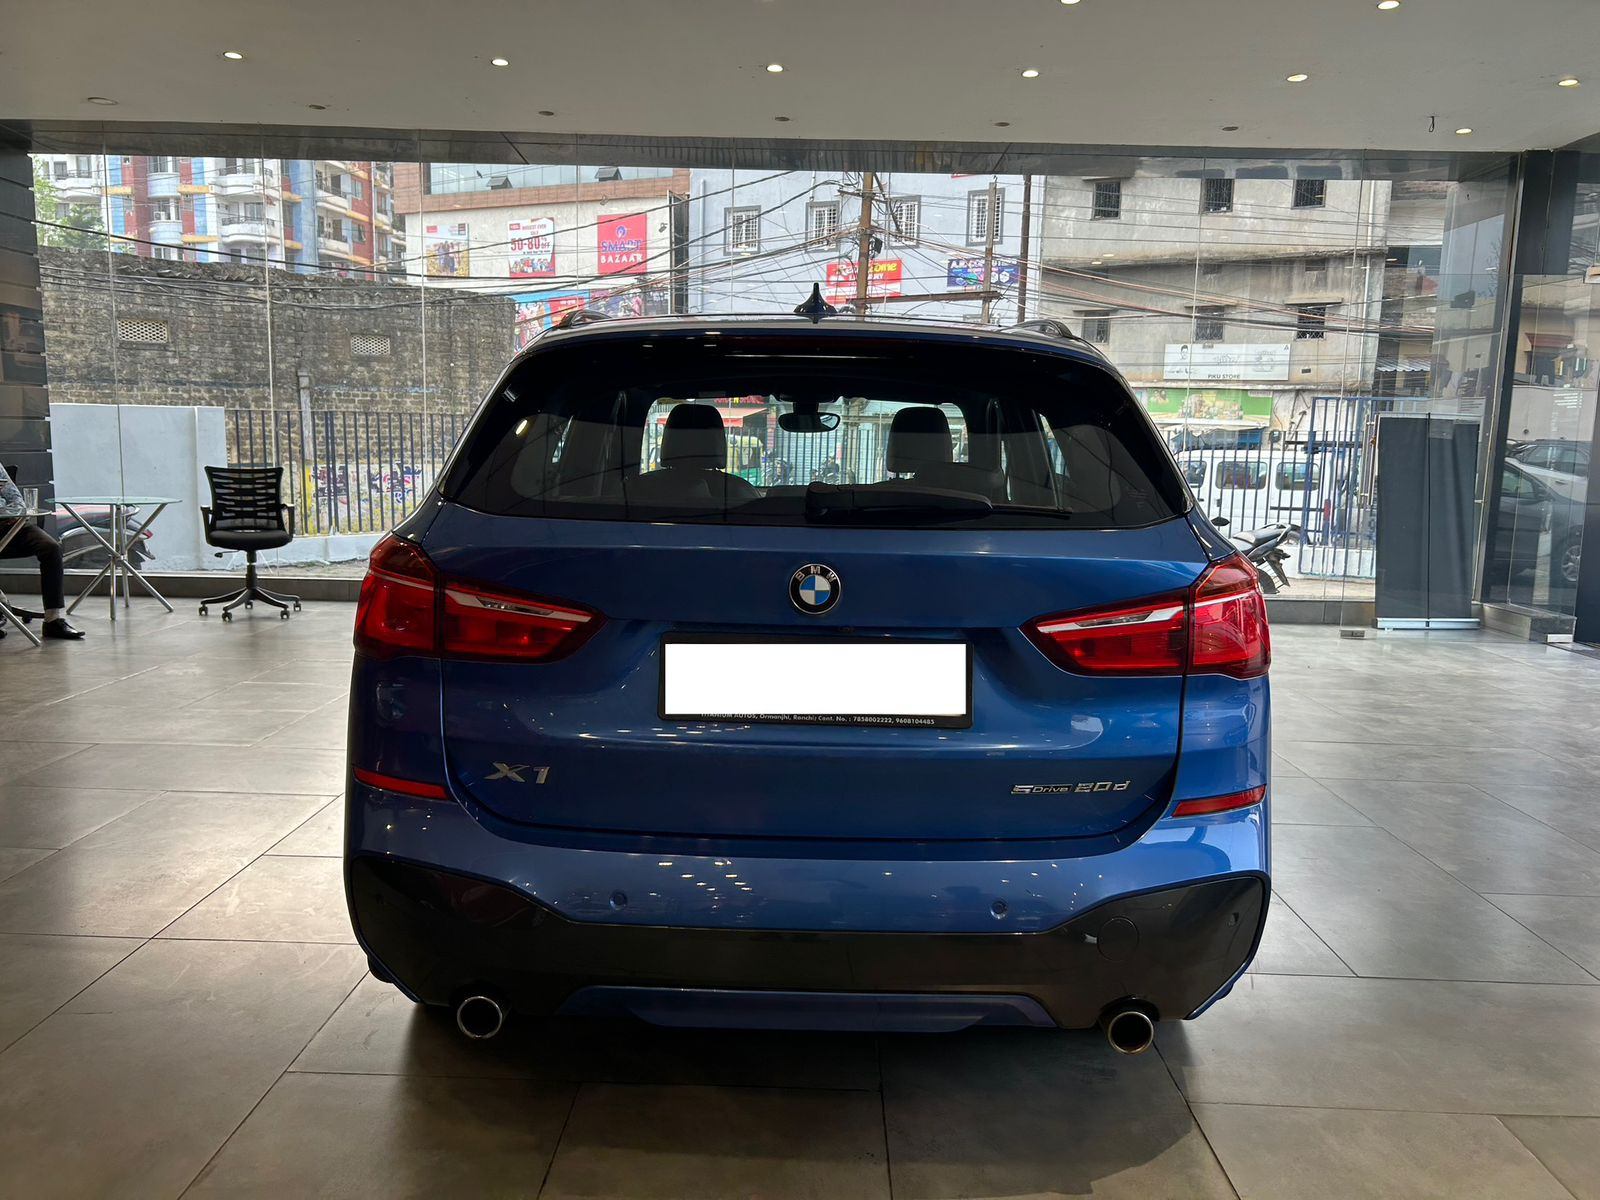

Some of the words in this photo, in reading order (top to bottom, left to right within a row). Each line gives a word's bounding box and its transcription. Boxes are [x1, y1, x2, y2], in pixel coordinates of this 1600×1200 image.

[600, 253, 643, 264] BAZAAR
[795, 565, 837, 583] BMW
[483, 761, 550, 784] X1
